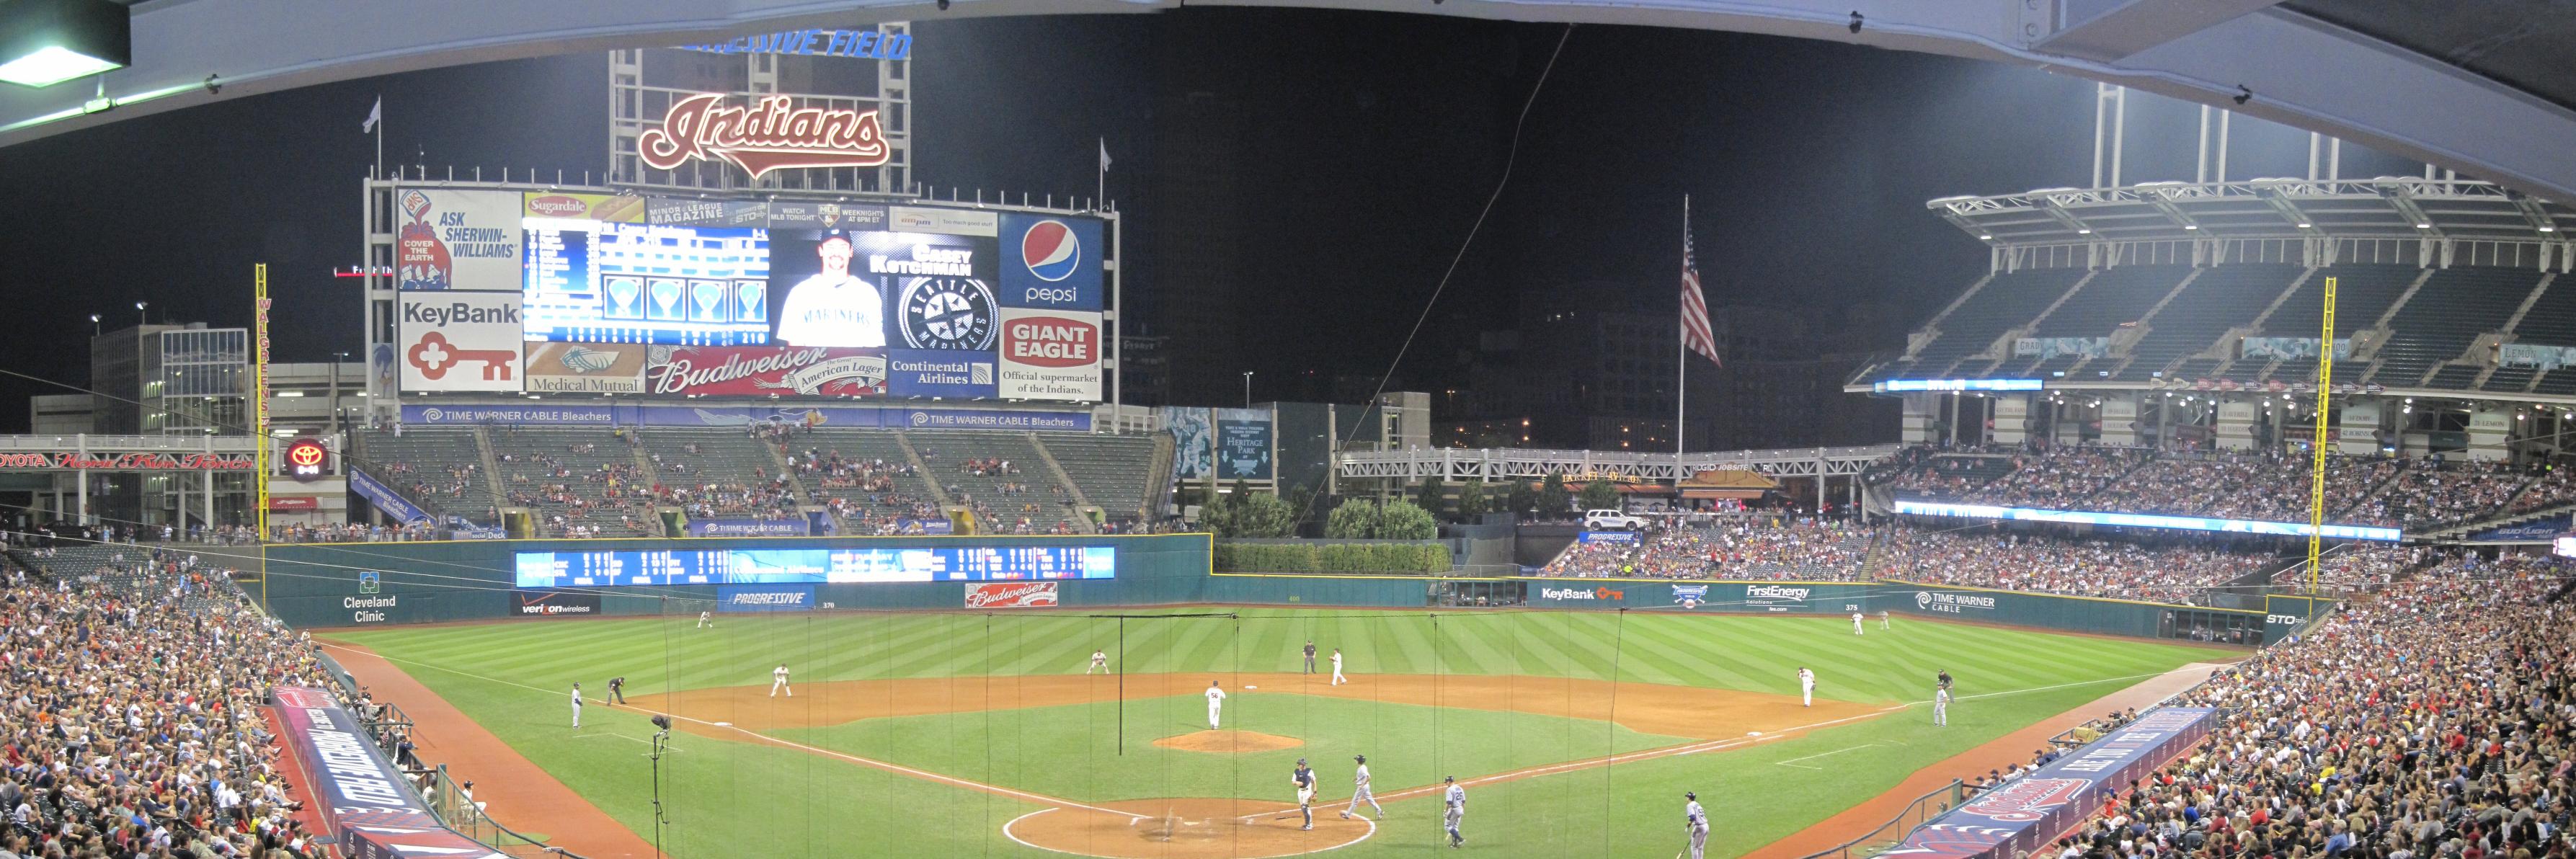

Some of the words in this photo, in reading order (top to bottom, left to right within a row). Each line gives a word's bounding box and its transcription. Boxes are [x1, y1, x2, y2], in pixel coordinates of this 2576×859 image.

[826, 30, 912, 59] FIELD
[639, 93, 890, 179] Indians
[405, 192, 423, 210] SWP
[531, 200, 587, 213] Sugardale
[649, 206, 680, 215] MINOR
[688, 202, 721, 211] LEAGUE
[439, 212, 466, 226] ASK
[650, 210, 724, 224] MAGAZINE
[445, 228, 507, 242] SHERWIN-
[453, 244, 513, 258] WILLIAMS
[912, 242, 972, 264] CASEY
[870, 254, 972, 276] KOTCHMAN
[911, 279, 979, 313] SEATTLE
[1026, 287, 1076, 304] pepsi
[404, 302, 518, 327] KeyBank
[1013, 324, 1089, 342] GIANT
[258, 298, 272, 412] WALGREENS
[1014, 342, 1087, 360] EAGLE
[2505, 349, 2536, 358] LEMON
[648, 346, 827, 394] Budweiser
[892, 361, 968, 373] Continental
[801, 365, 850, 388] American
[852, 362, 884, 375] Lager
[918, 374, 968, 385] Airlines
[1003, 371, 1037, 380] Official
[1041, 374, 1098, 383] supermarket
[533, 378, 586, 391] Medical
[591, 379, 638, 392] Mutual
[1018, 384, 1027, 393] of
[1047, 385, 1084, 394] Indians.
[445, 411, 472, 420] TIME
[474, 411, 521, 420] WARNER
[524, 411, 558, 421] CABLE
[562, 411, 611, 422] Bleachers
[931, 415, 954, 424] TIME
[956, 416, 996, 425] WARNER
[999, 417, 1029, 426] CABLE
[1031, 417, 1074, 427] Bleachers
[1227, 437, 1263, 447] HERITAGE
[1238, 445, 1255, 454] PARK
[55, 453, 116, 468] HOME
[118, 453, 175, 468] RUN
[358, 477, 372, 491] TIME
[370, 485, 393, 504] WARNER
[392, 499, 409, 513] CABLE
[383, 502, 407, 519] Bleachers
[734, 592, 806, 605] PROGRESSIVE
[967, 583, 1046, 607] Budweiser
[1542, 588, 1595, 600] KeyBank
[1747, 585, 1810, 599] FirstEnergy
[344, 595, 396, 608] Cleveland
[1932, 593, 1955, 604] TIME
[1956, 595, 1995, 607] WARNER
[523, 604, 563, 613] verizon
[1932, 604, 1960, 613] CABLE
[355, 610, 385, 623] Clinic
[2266, 614, 2296, 625] STO
